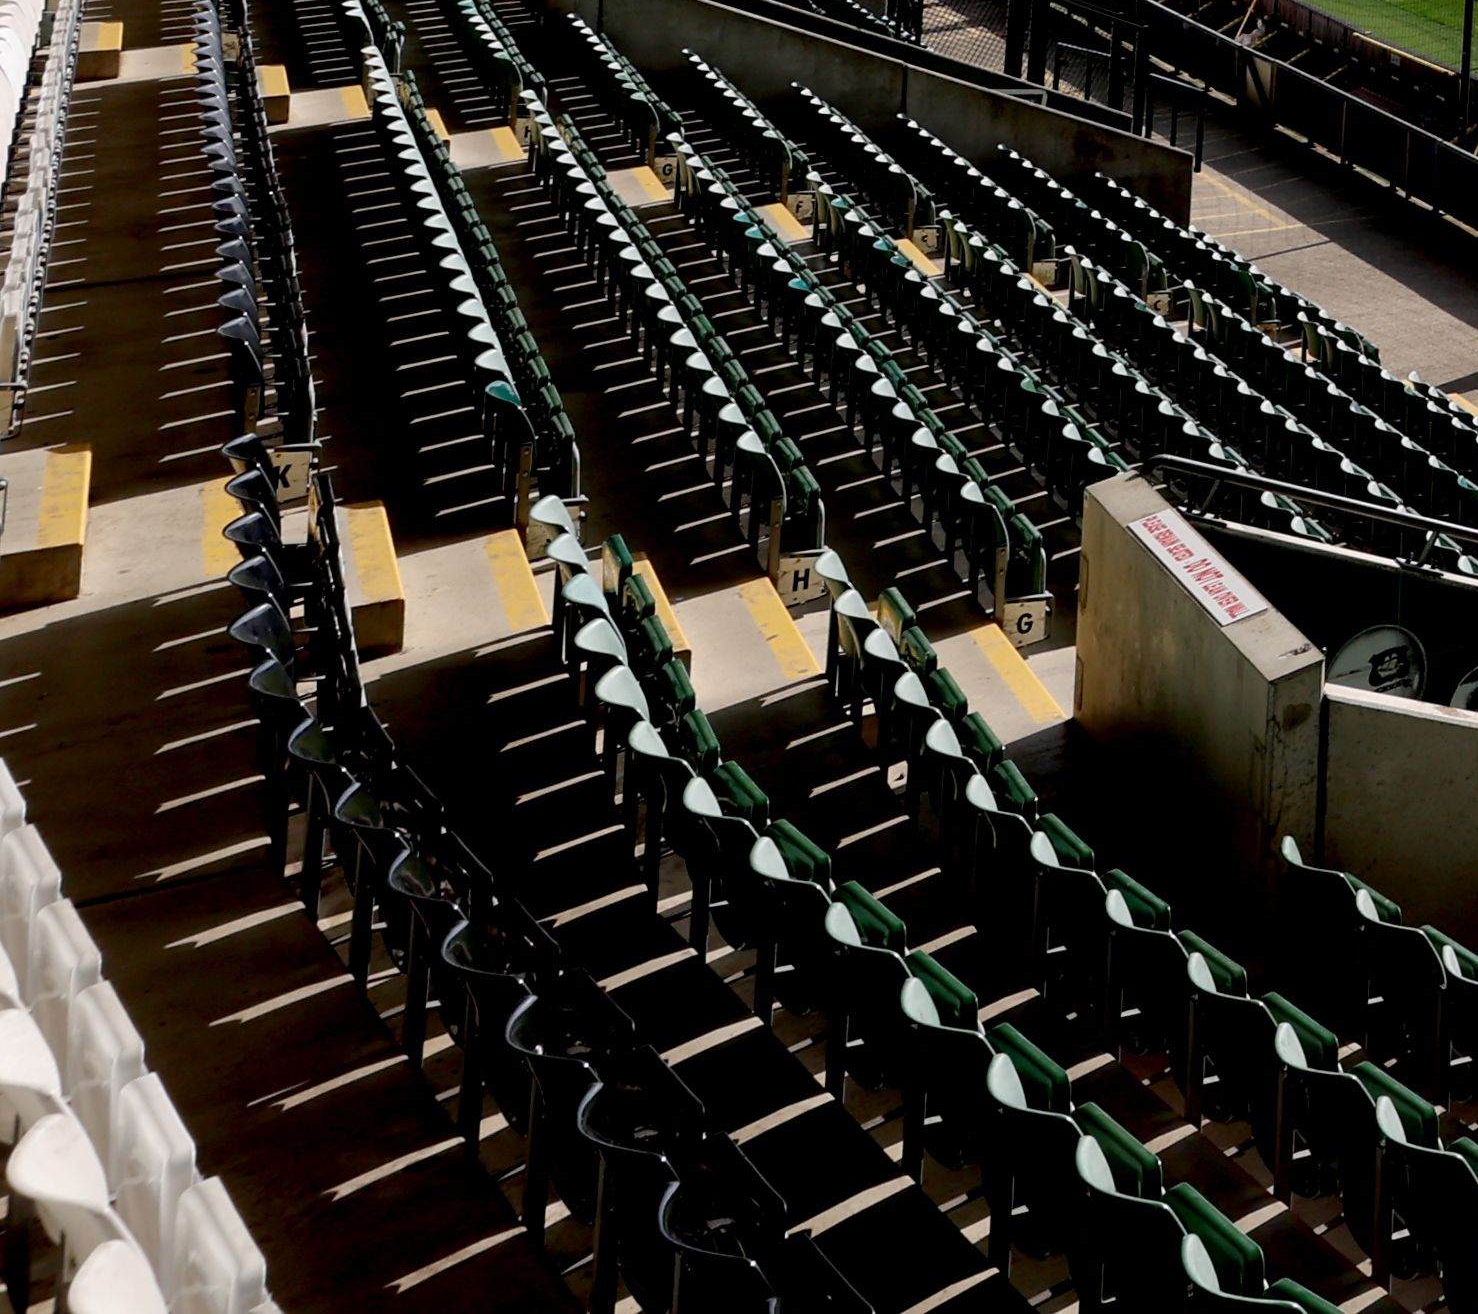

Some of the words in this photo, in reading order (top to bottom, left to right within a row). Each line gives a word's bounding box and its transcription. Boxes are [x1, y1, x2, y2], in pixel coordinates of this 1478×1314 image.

[1141, 515, 1168, 534] PLEASE
[1155, 529, 1180, 547] REMAIN
[1167, 543, 1194, 562] SEATED
[1184, 558, 1212, 573] DO
[793, 567, 811, 590] H
[1191, 567, 1224, 585] NOT
[1203, 582, 1228, 599] LEAN
[1213, 591, 1239, 606] OVER
[1225, 603, 1249, 619] WALL
[1016, 612, 1035, 636] G
